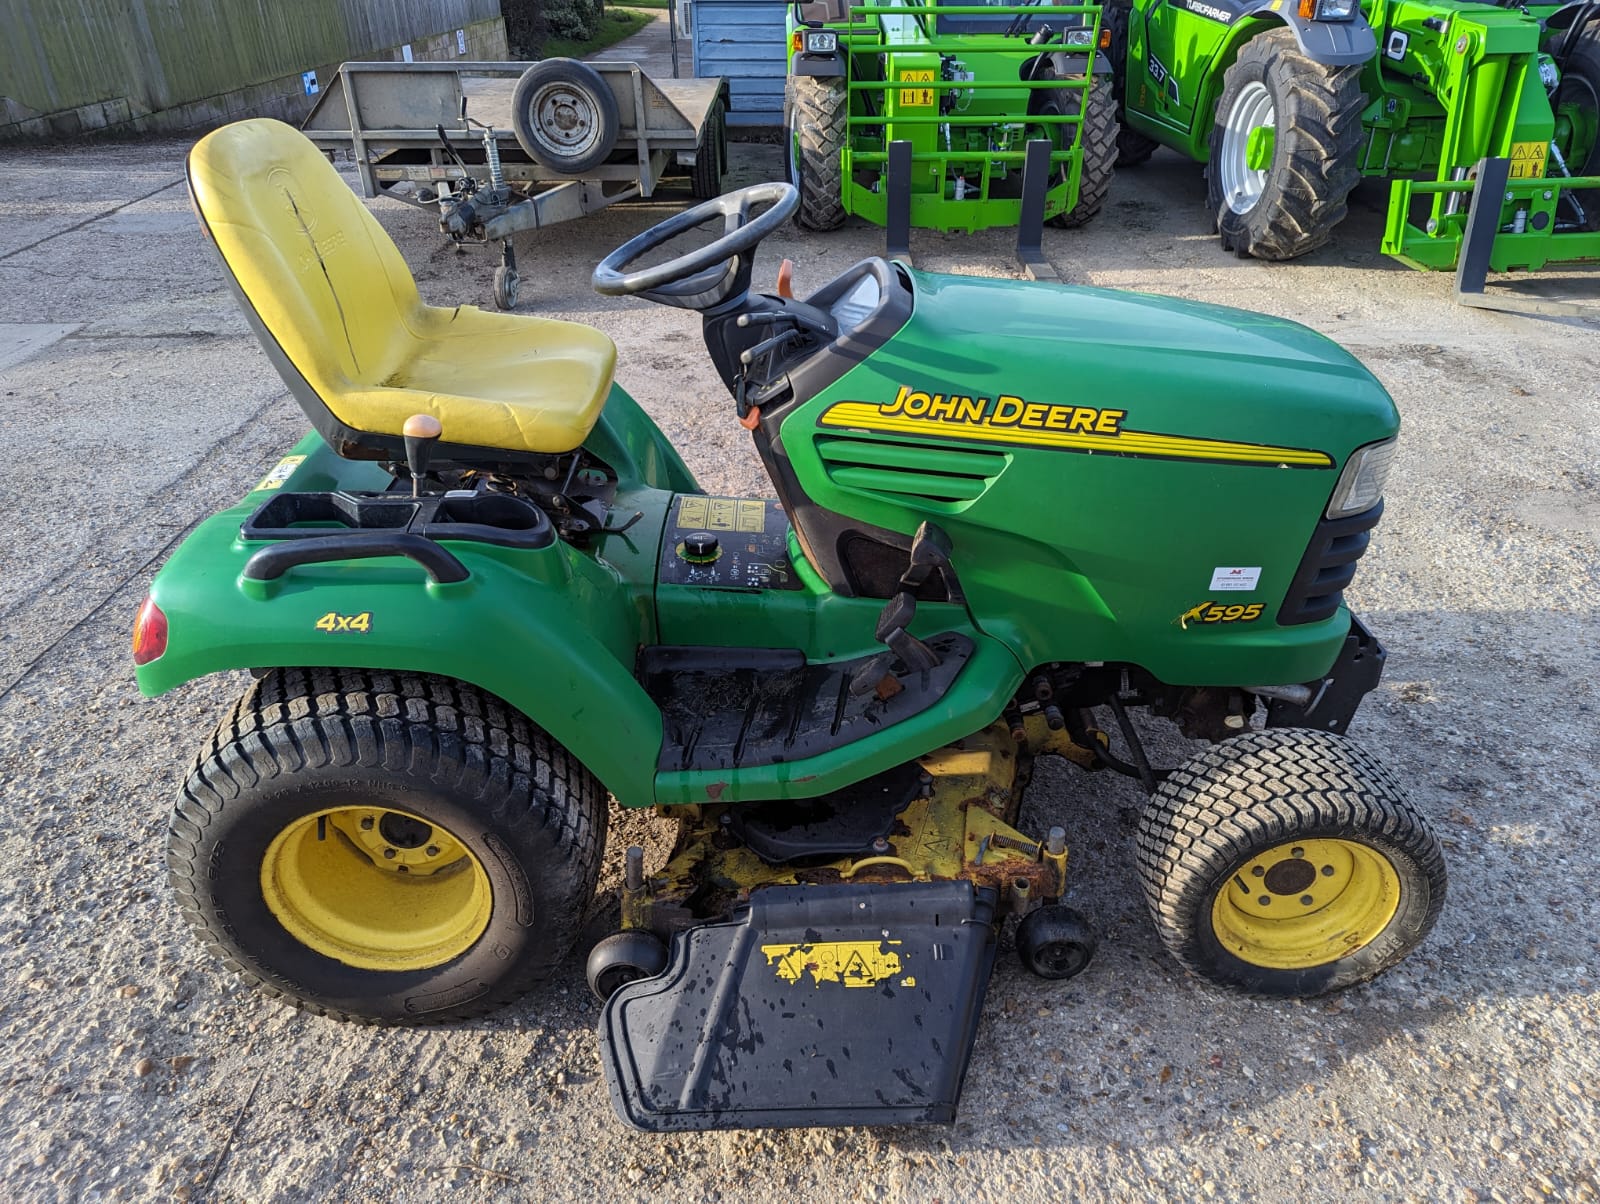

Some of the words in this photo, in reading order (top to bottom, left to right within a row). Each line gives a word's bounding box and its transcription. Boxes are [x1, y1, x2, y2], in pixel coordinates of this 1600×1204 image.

[1186, 0, 1232, 23] TURBOFARMER
[880, 386, 986, 421] JOHN
[991, 396, 1123, 434] DEERE
[316, 612, 370, 632] 4x4
[1181, 601, 1265, 623] X595
